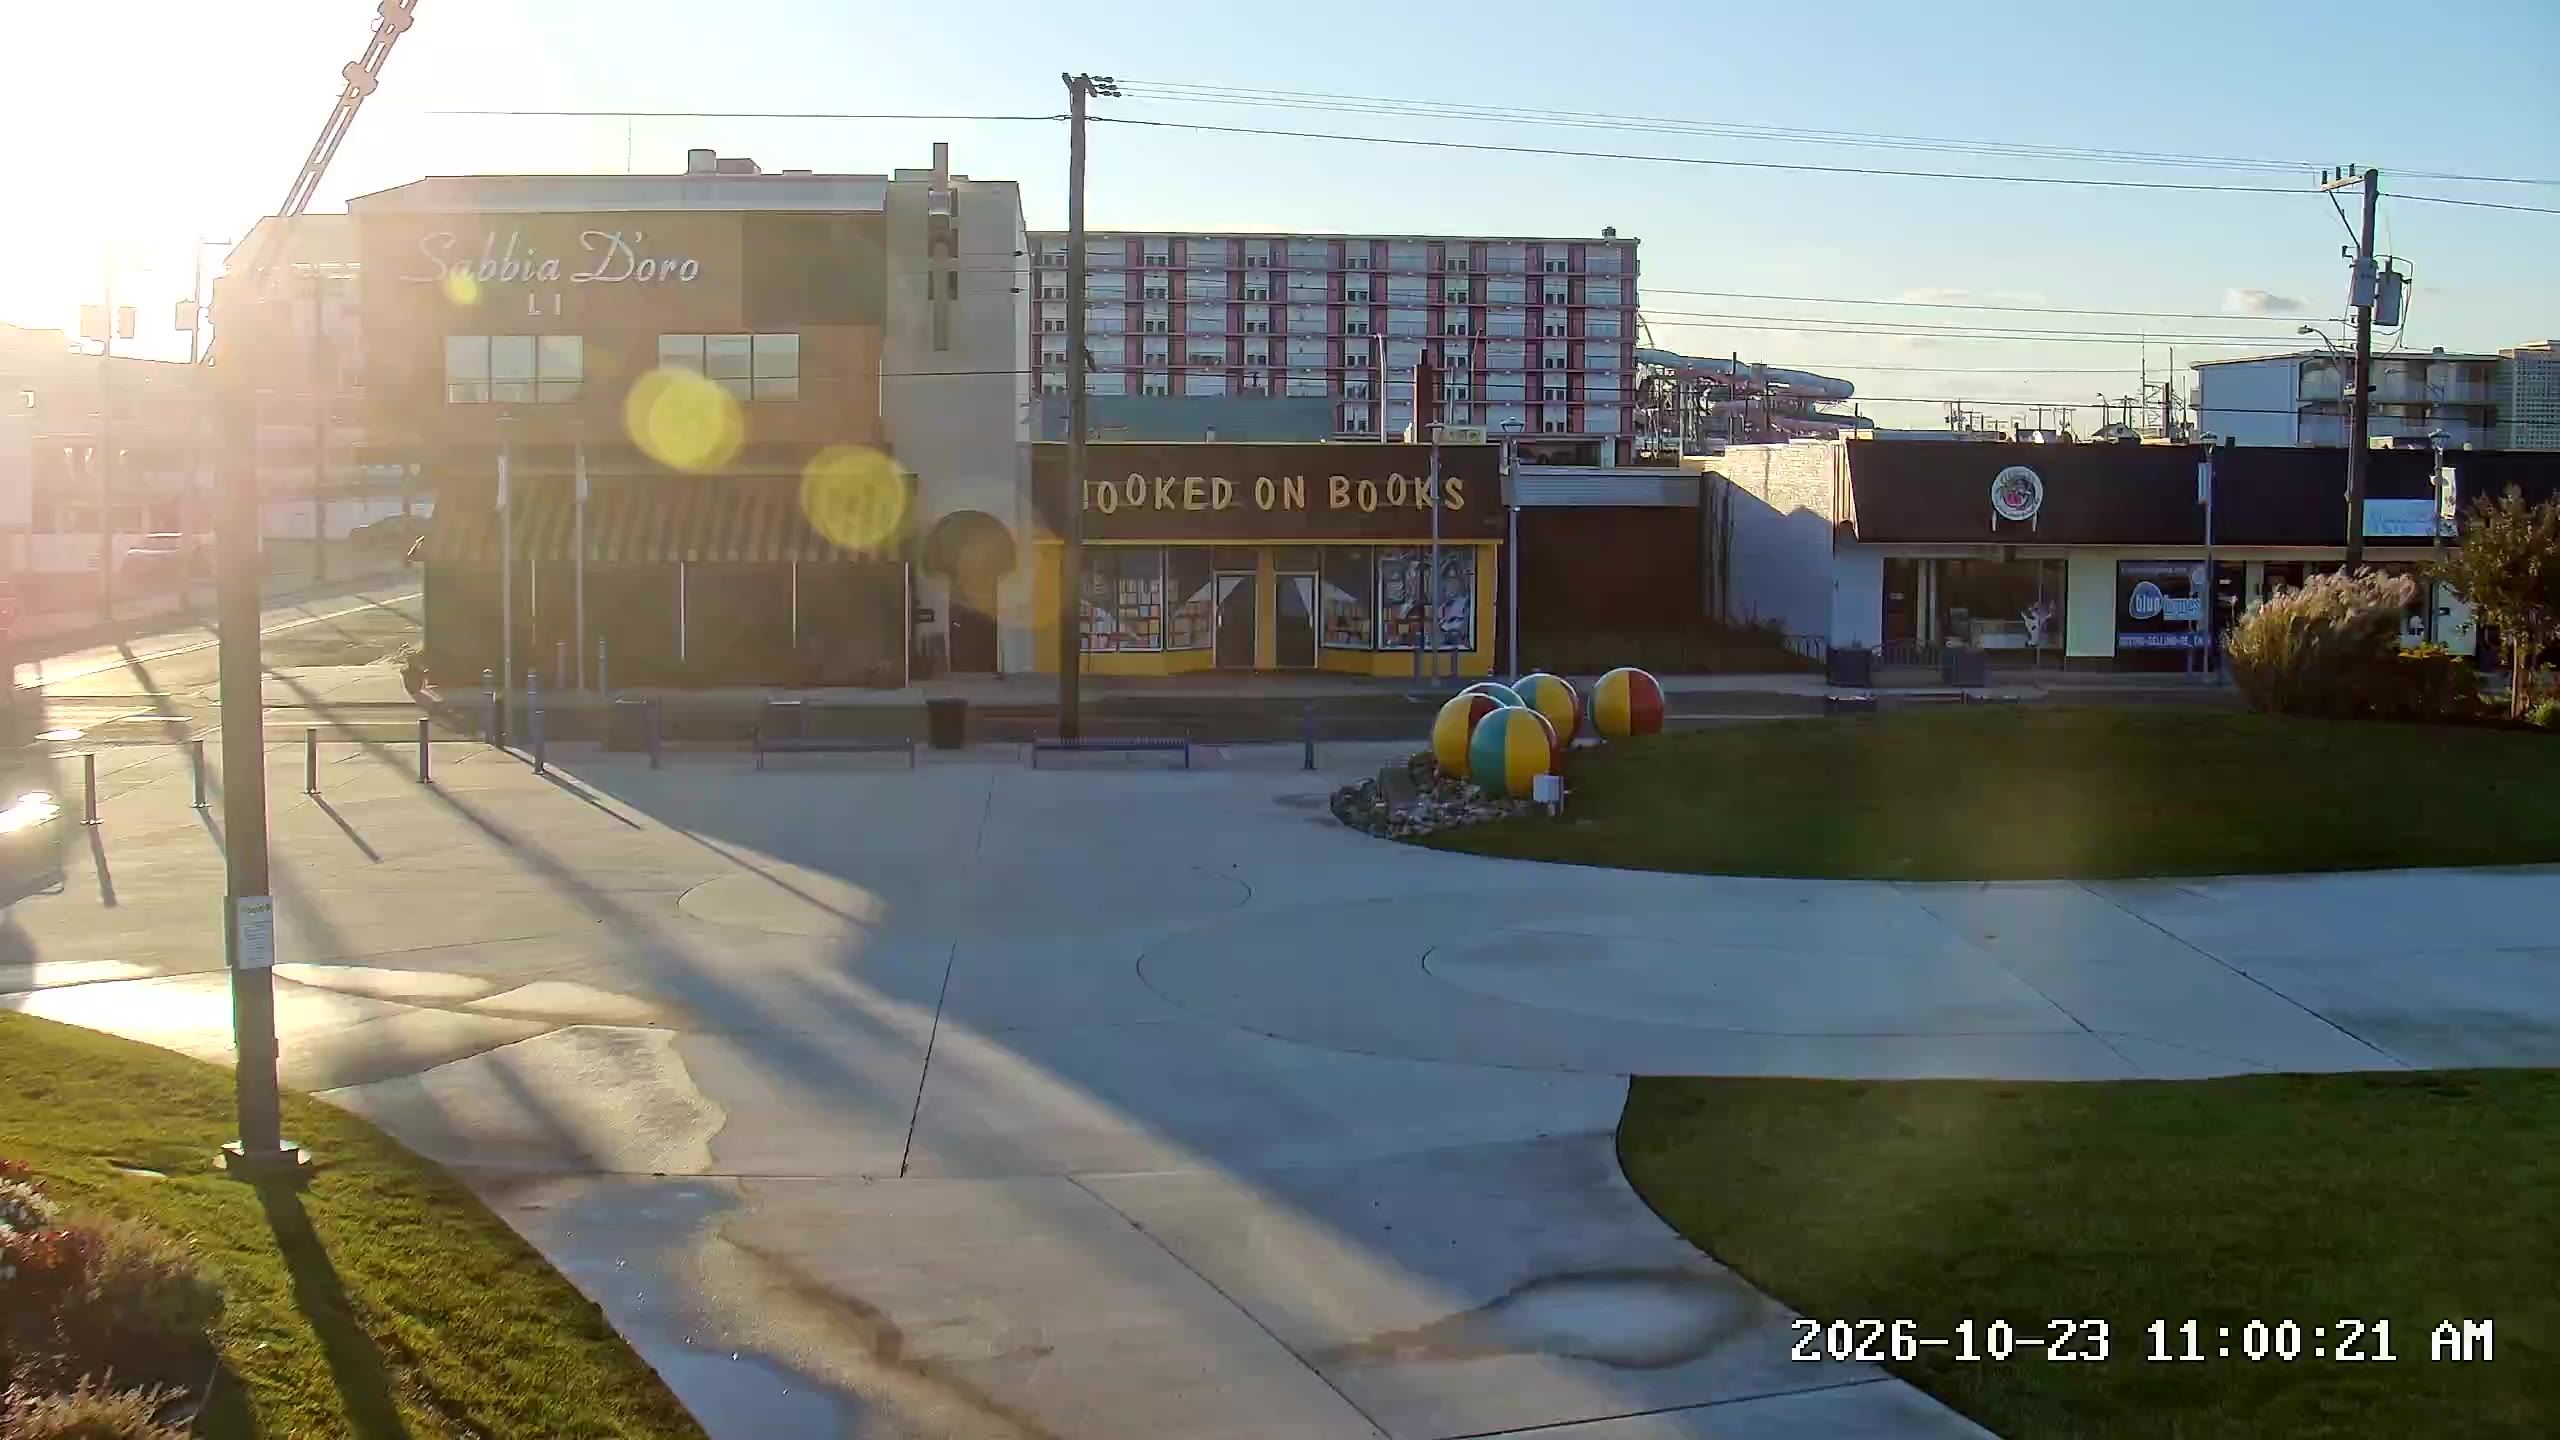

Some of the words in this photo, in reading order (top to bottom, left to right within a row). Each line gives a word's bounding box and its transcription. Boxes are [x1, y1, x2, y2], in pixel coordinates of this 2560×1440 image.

[399, 230, 561, 283] Sabbia
[1255, 475, 1304, 511] ON
[1329, 472, 1465, 513] BOOKS
